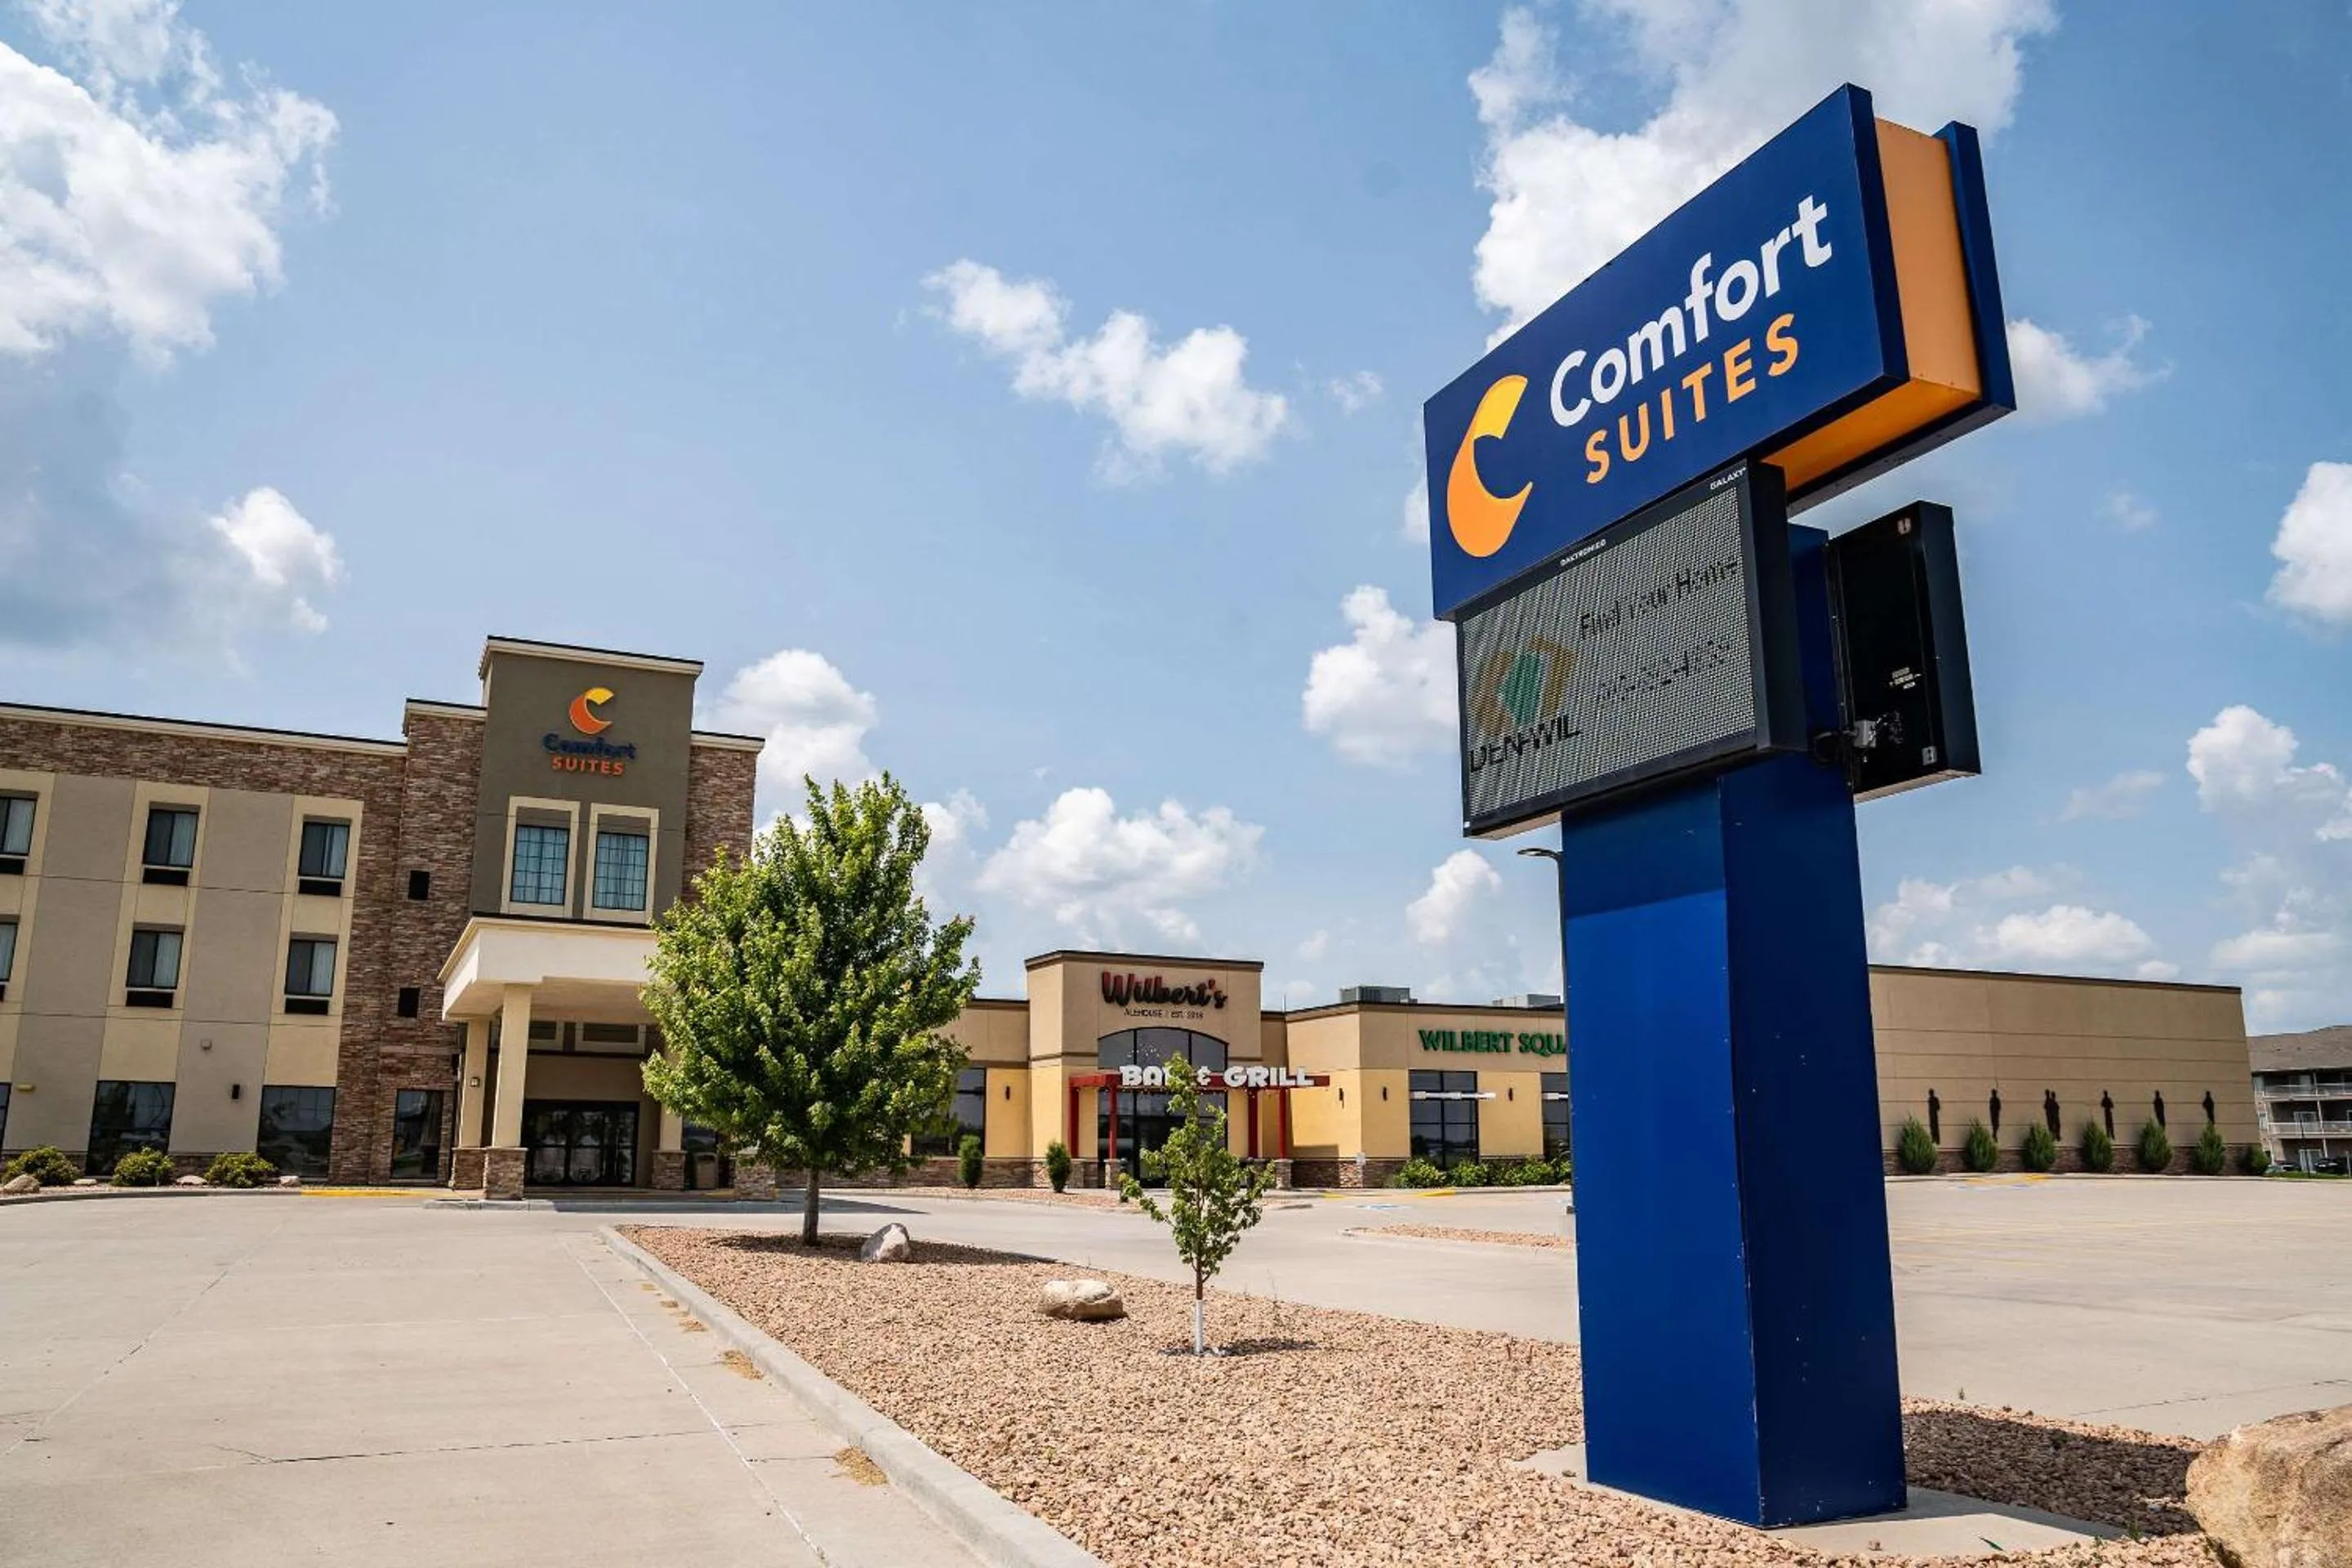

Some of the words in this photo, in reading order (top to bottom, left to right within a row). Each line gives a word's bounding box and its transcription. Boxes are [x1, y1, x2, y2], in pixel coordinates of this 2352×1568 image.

[1550, 194, 1833, 428] Comfort
[1584, 313, 1799, 483] SUITES
[542, 733, 636, 760] Comfort
[550, 755, 625, 777] SUITES
[1101, 971, 1228, 1009] Wilbert's
[1418, 1029, 1514, 1054] WILBERT
[1518, 1031, 1566, 1058] SQU
[1223, 1065, 1314, 1087] GRILL
